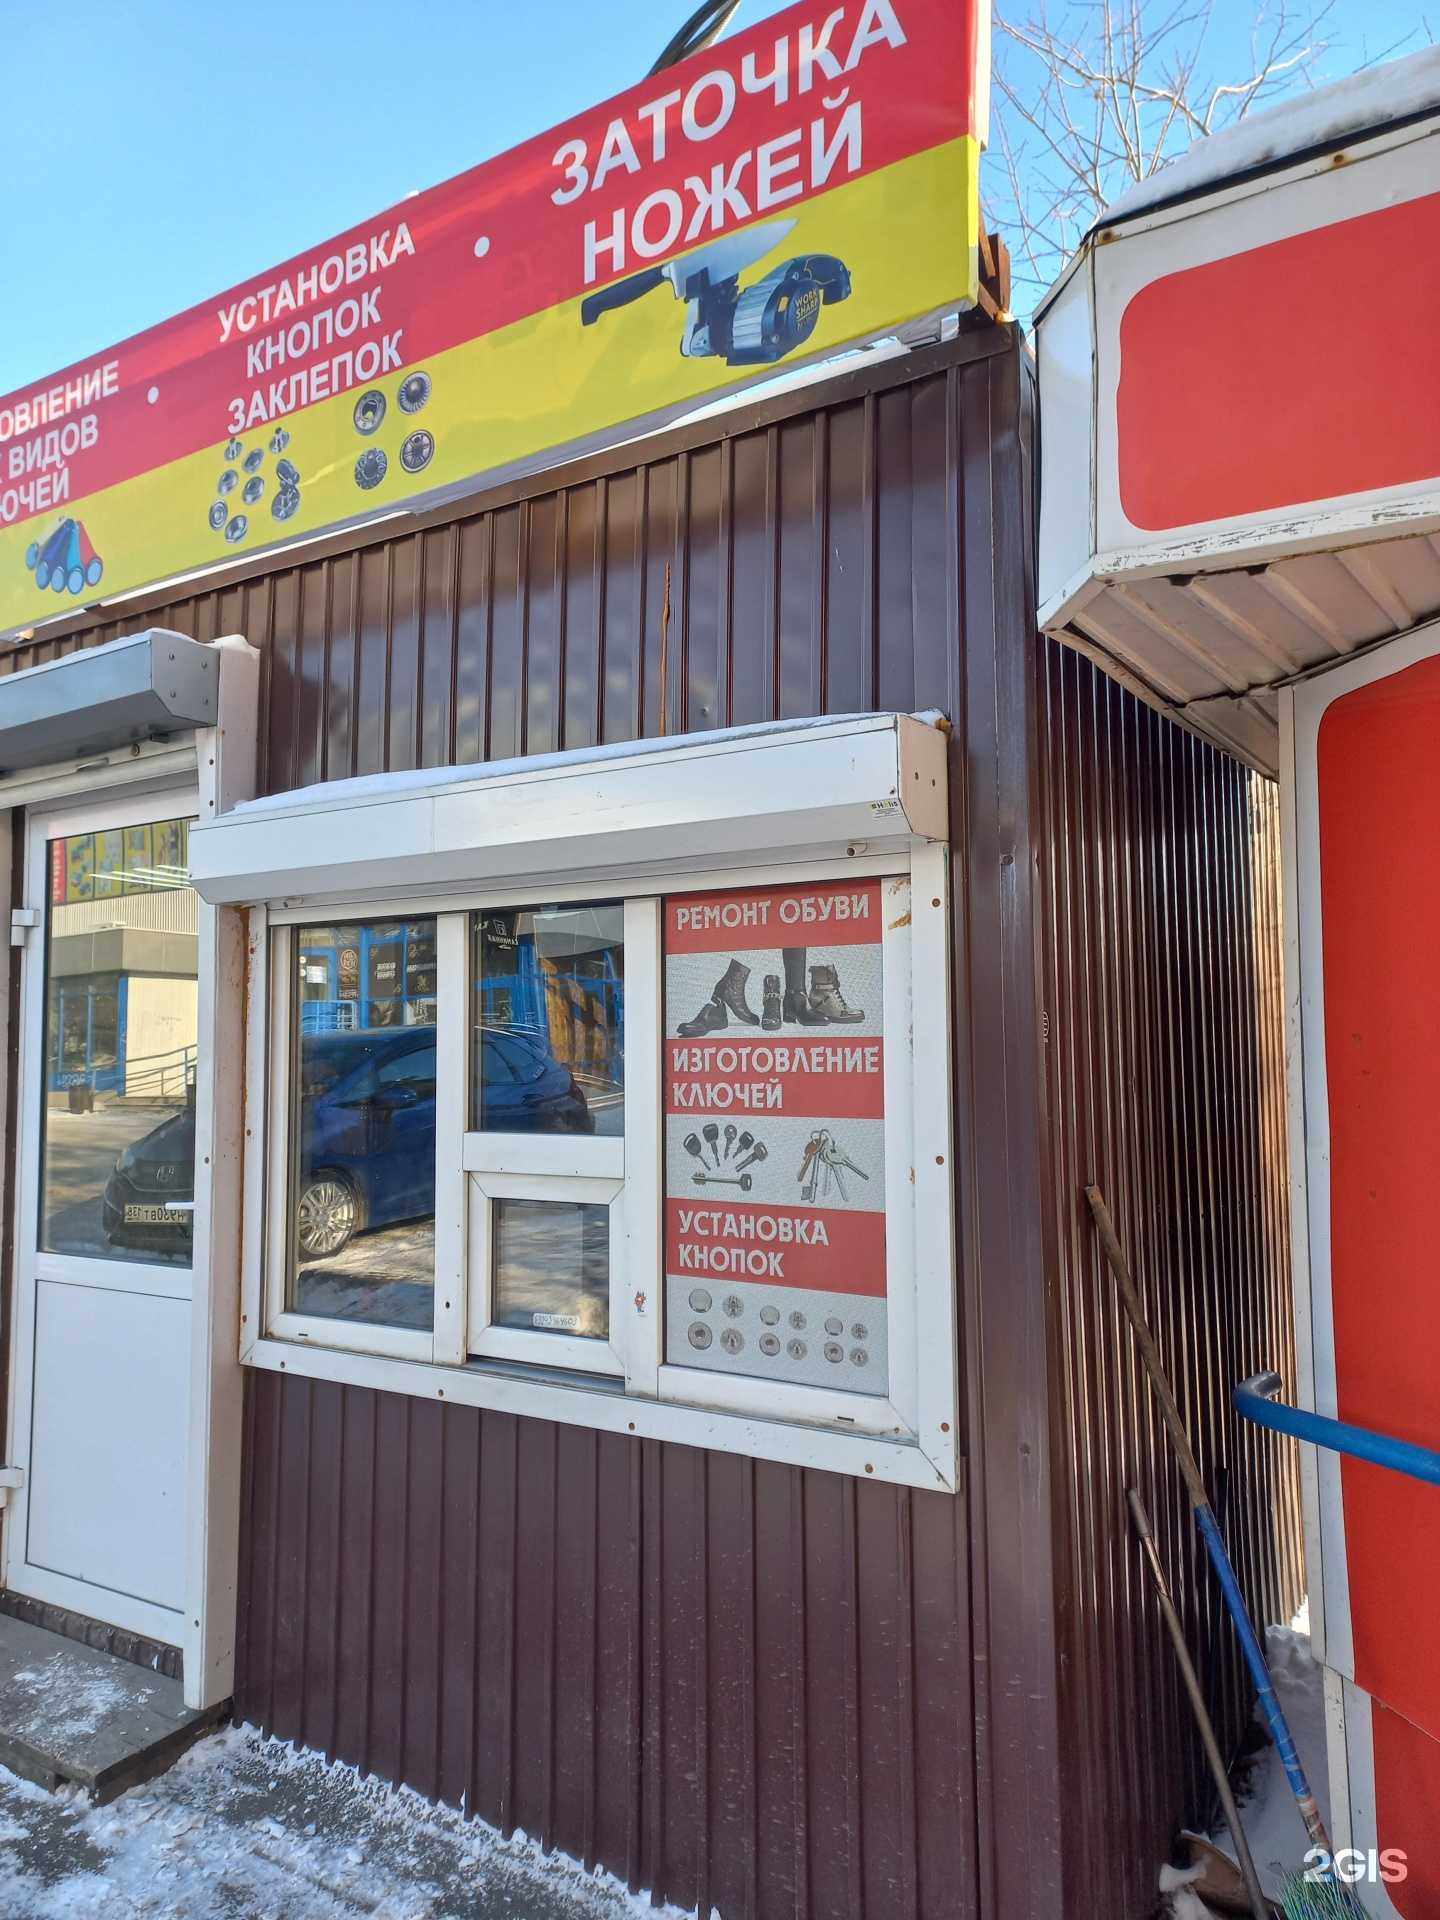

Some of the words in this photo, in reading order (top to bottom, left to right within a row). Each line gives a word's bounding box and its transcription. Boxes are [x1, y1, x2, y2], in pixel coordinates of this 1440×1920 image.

[551, 0, 907, 206] ЗАТОЧКА
[583, 88, 863, 285] НОЖЕЙ
[217, 222, 416, 343] УСТАНОВКА
[246, 286, 382, 379] КНОПОК
[226, 329, 403, 435] ЗАКЛЕПОК
[8, 413, 98, 480] ВИДОВ
[676, 900, 771, 931] РЕМОНТ
[779, 894, 869, 924] ОБУВИ
[672, 1045, 880, 1073] ИЗГОТОВЛЕНИЕ
[672, 1078, 783, 1109] КЛЮЧЕЙ
[678, 1210, 829, 1246] УСТАНОВКА
[678, 1244, 785, 1278] КНОПОК
